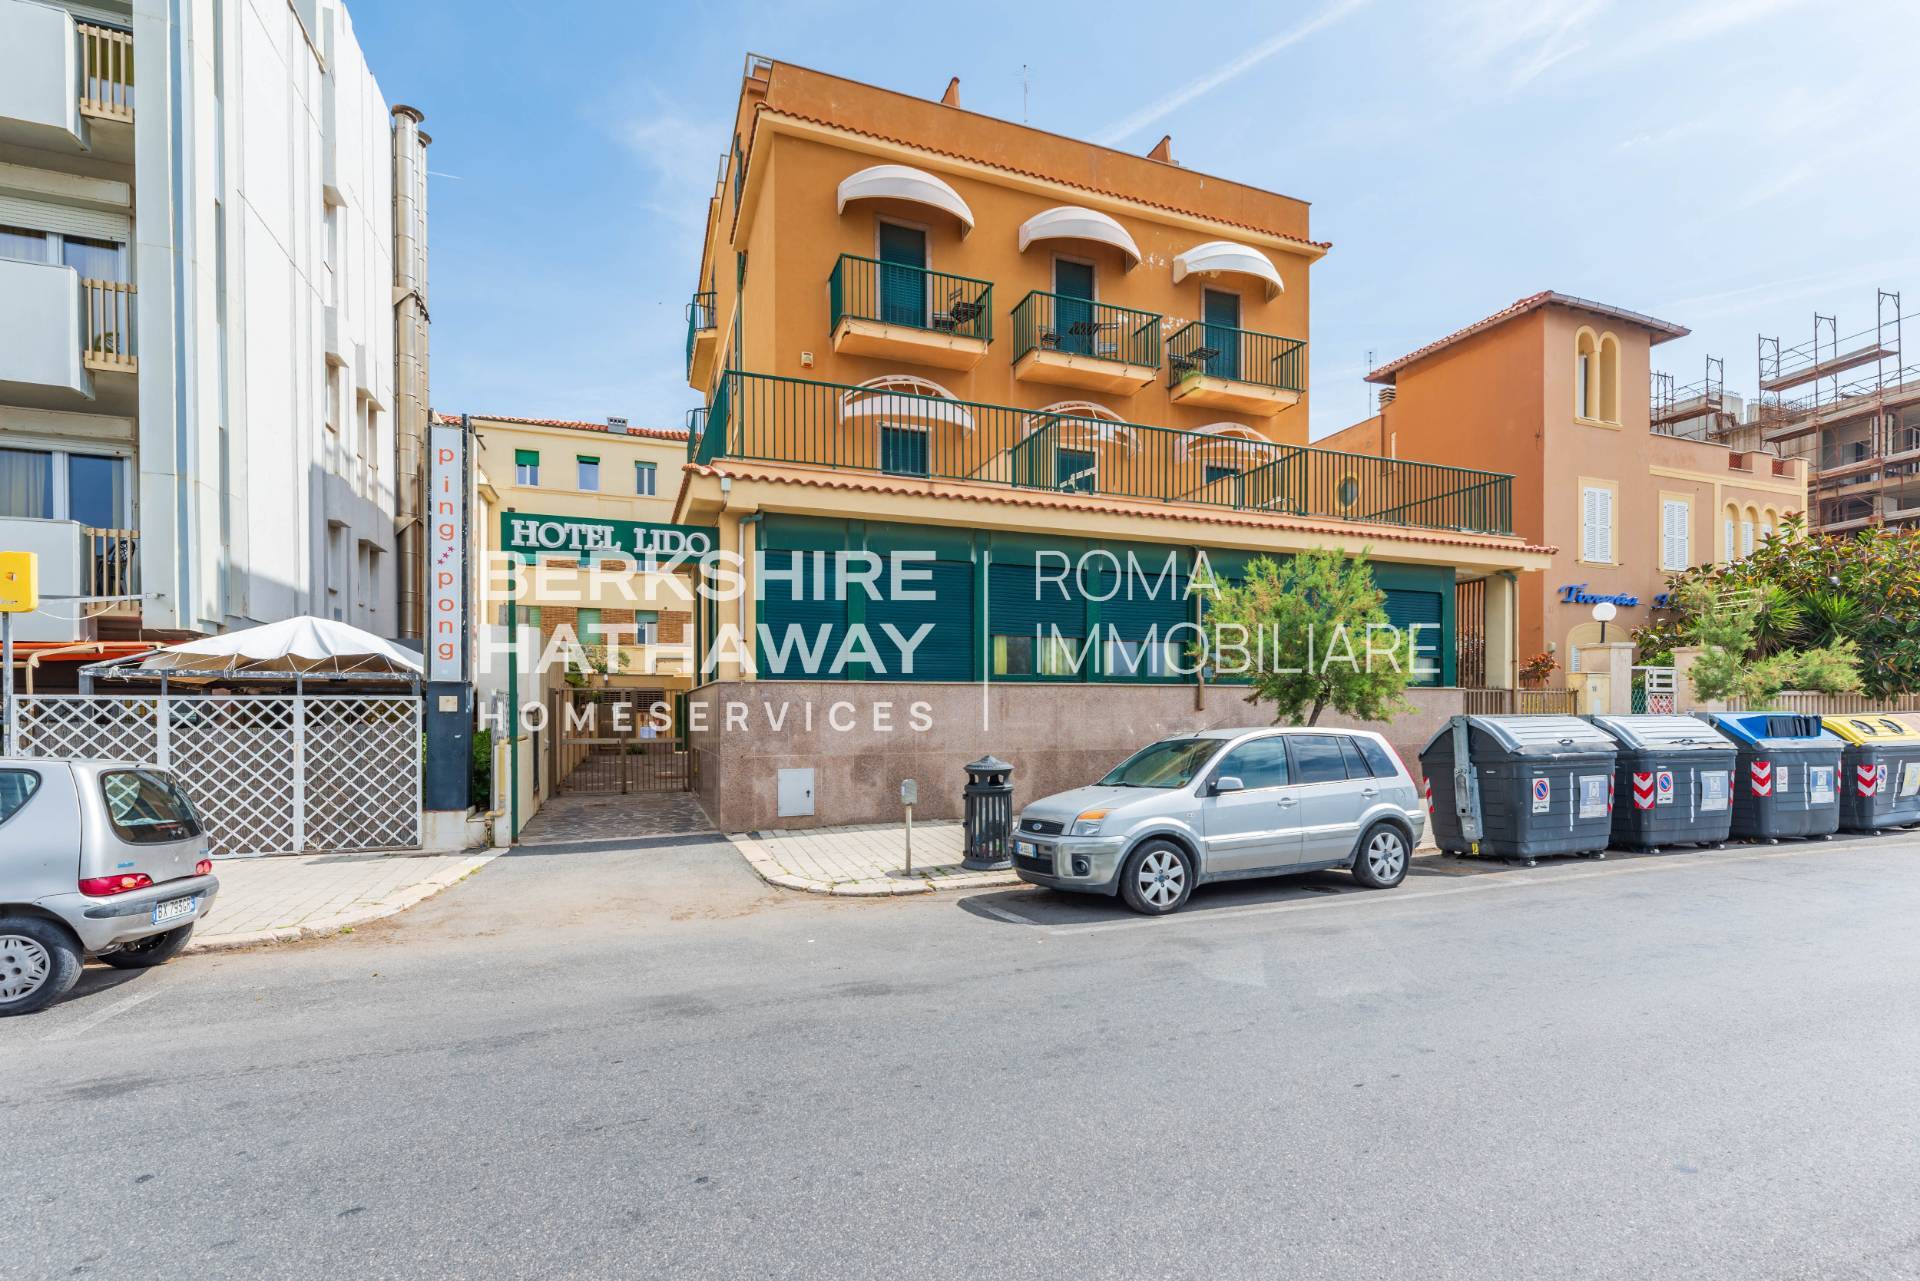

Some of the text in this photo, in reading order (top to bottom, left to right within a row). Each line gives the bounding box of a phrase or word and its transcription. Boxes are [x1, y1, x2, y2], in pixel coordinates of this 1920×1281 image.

[438, 448, 455, 661] ping pong
[510, 519, 711, 558] HOTEL LIDO
